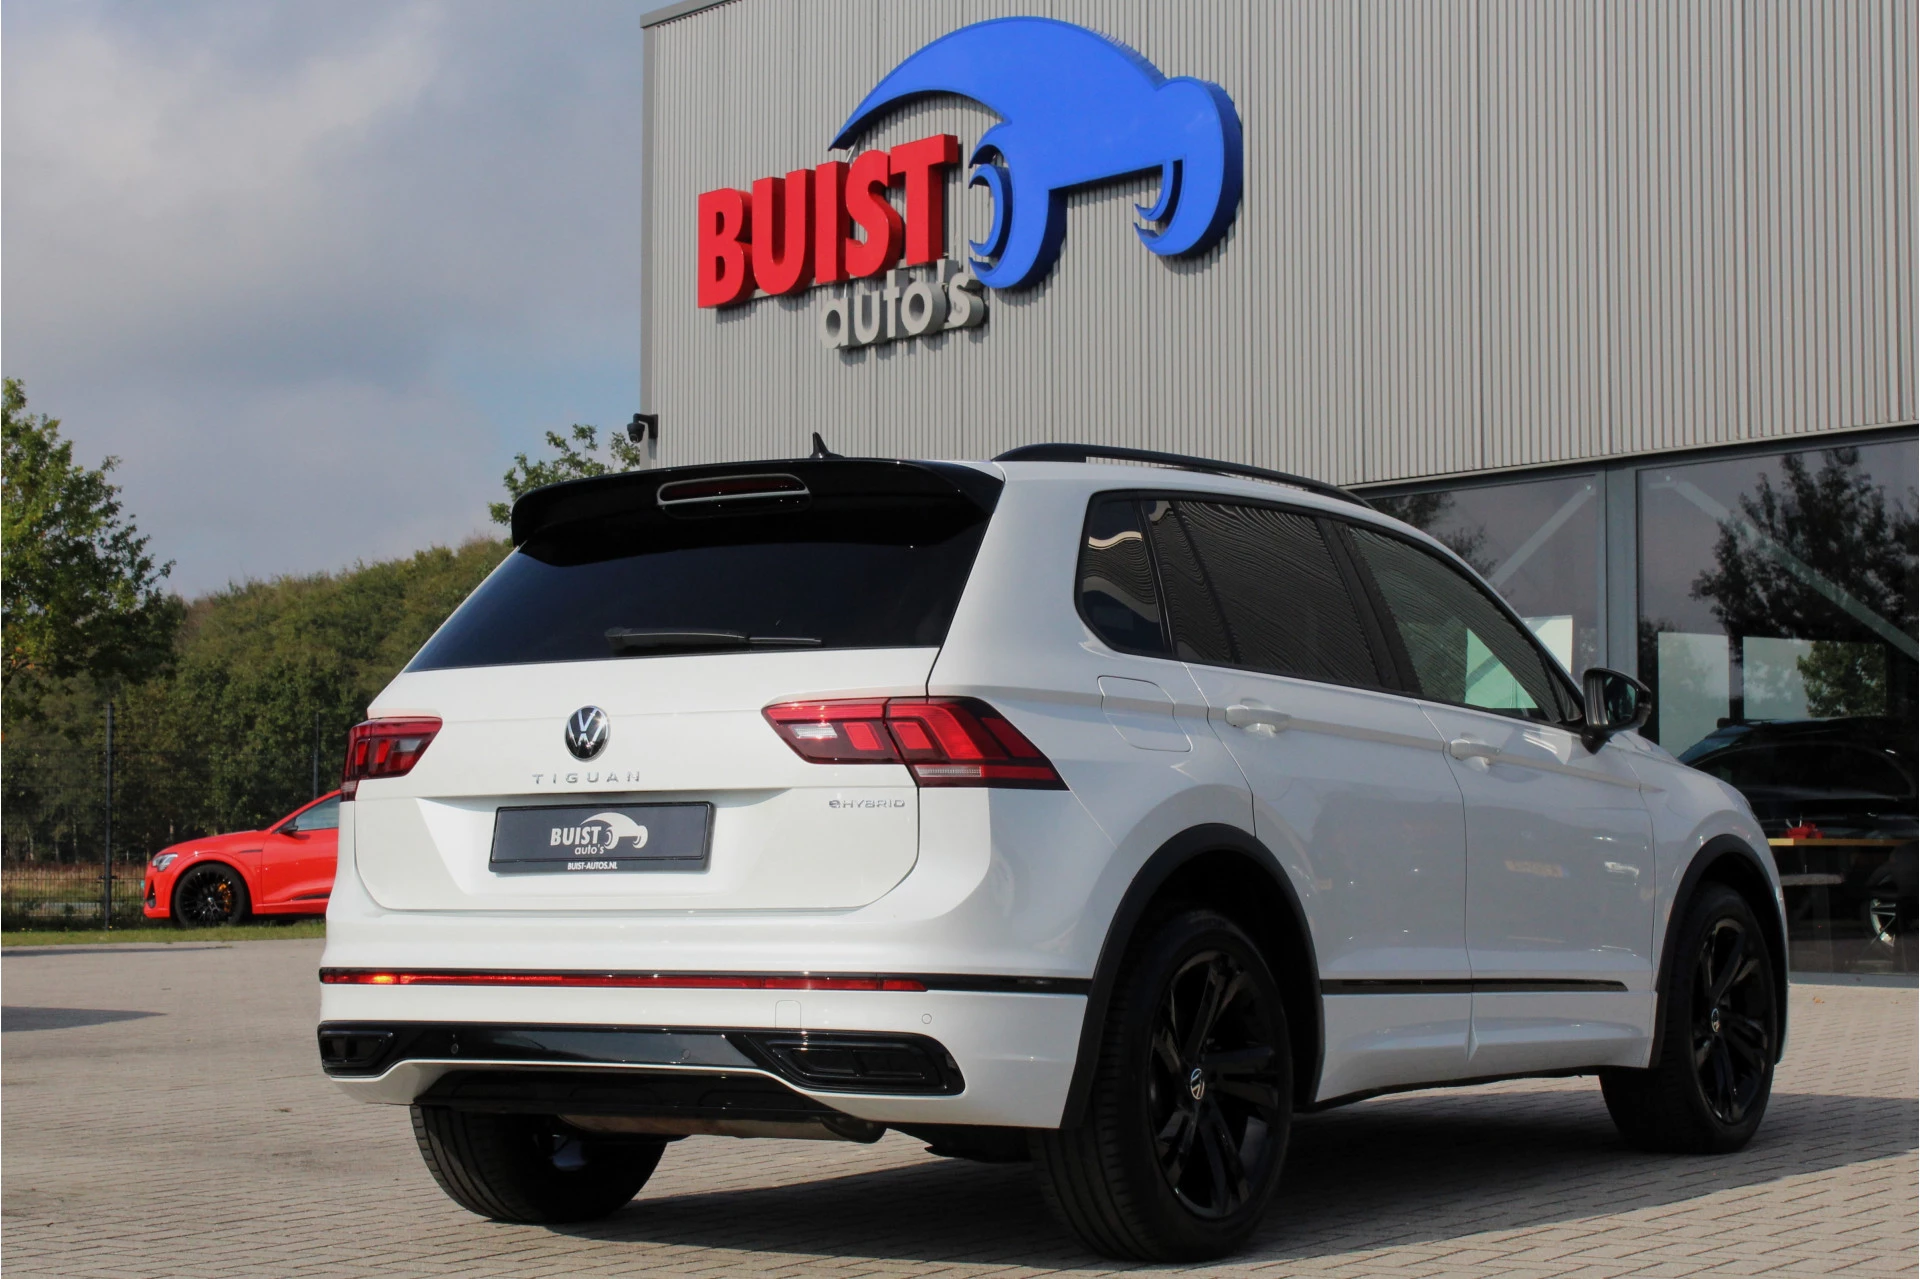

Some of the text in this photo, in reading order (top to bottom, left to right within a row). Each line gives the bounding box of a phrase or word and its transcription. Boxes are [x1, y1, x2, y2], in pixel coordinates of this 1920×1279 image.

[698, 134, 958, 309] BUIST
[820, 258, 984, 349] auto's
[532, 771, 641, 784] TIGUAN
[550, 826, 602, 846] BUIST
[574, 845, 605, 855] auto's
[567, 861, 618, 871] BUIST-AUTOS.NL
